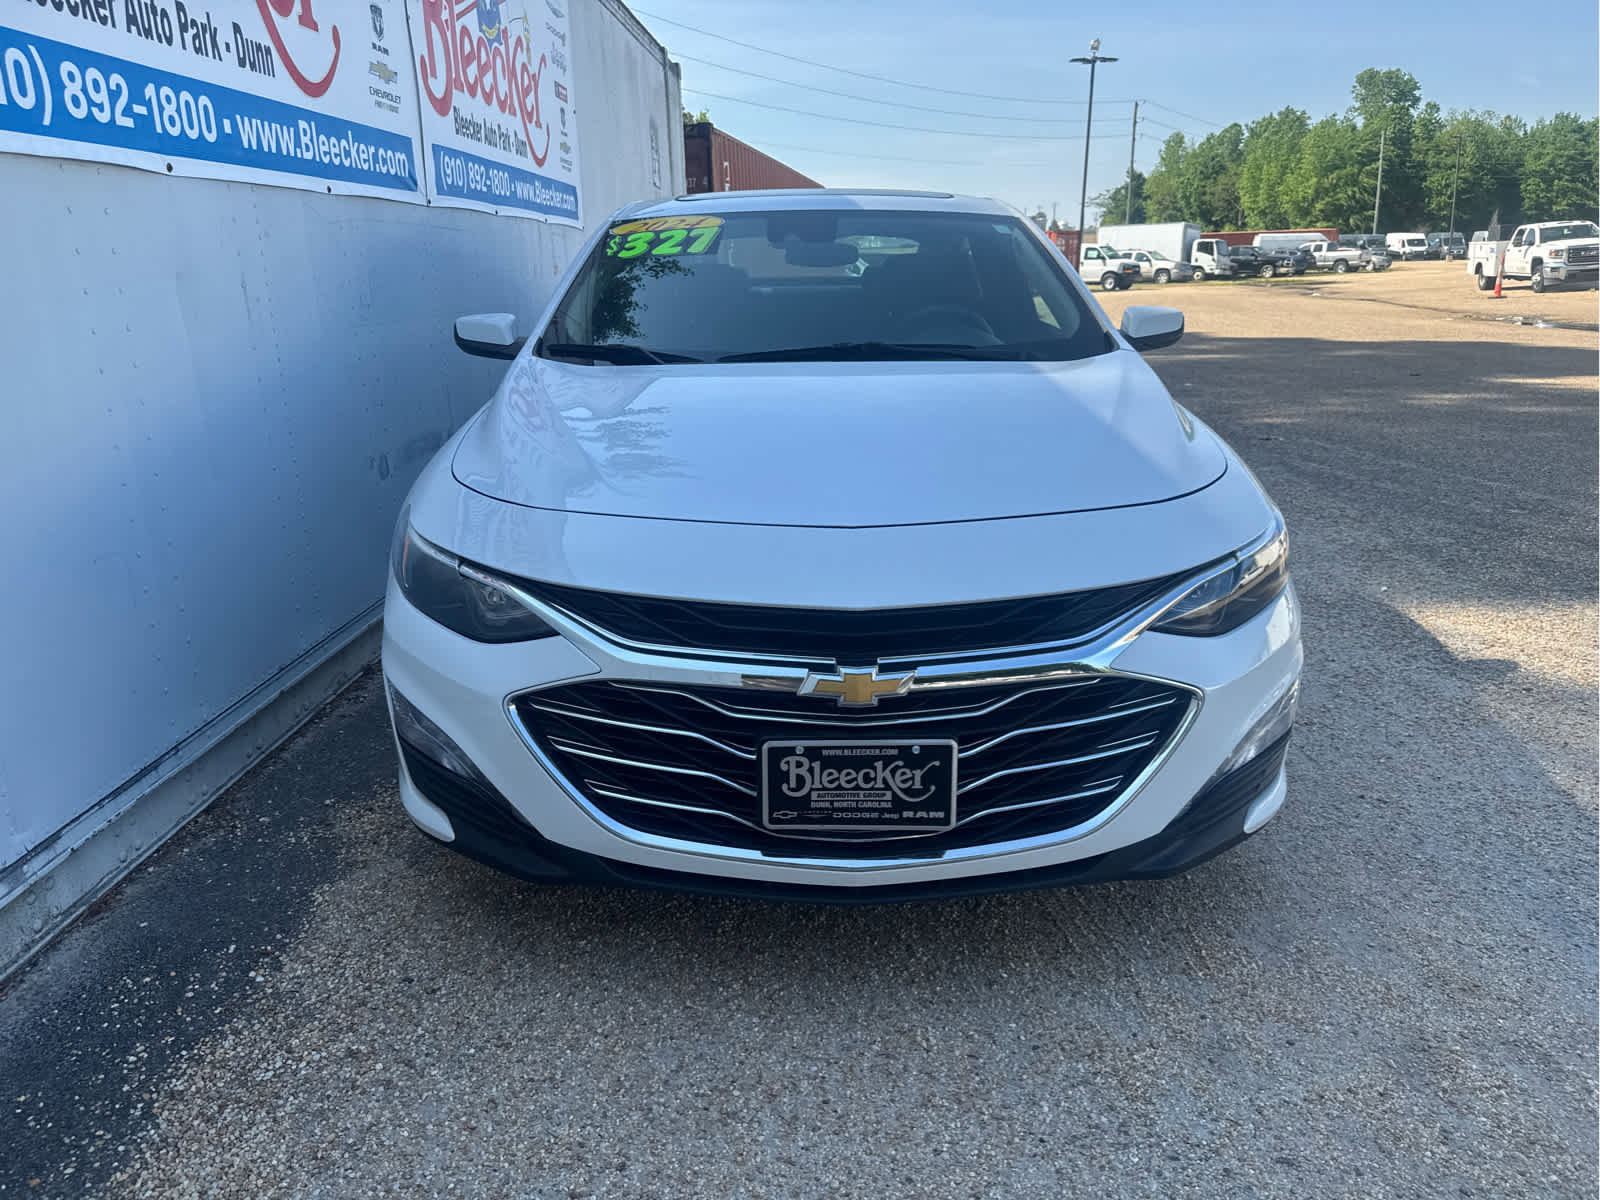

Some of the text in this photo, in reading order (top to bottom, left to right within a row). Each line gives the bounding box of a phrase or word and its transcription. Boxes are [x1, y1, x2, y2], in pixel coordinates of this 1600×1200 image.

[125, 0, 174, 47] Auto
[177, 0, 223, 62] Park
[231, 21, 276, 77] Dunn
[368, 85, 402, 105] CHEVROLET
[59, 60, 217, 143] 892-1800
[235, 113, 410, 177] www.Bleecker.com
[453, 105, 483, 142] Bleecker
[484, 118, 498, 149] Auto
[440, 151, 577, 212] (910) 892-1800 www.Bleecker.com
[606, 226, 721, 258] $327
[816, 791, 887, 799] AUTOMOTIVE GROUP
[902, 810, 945, 819] RAM
